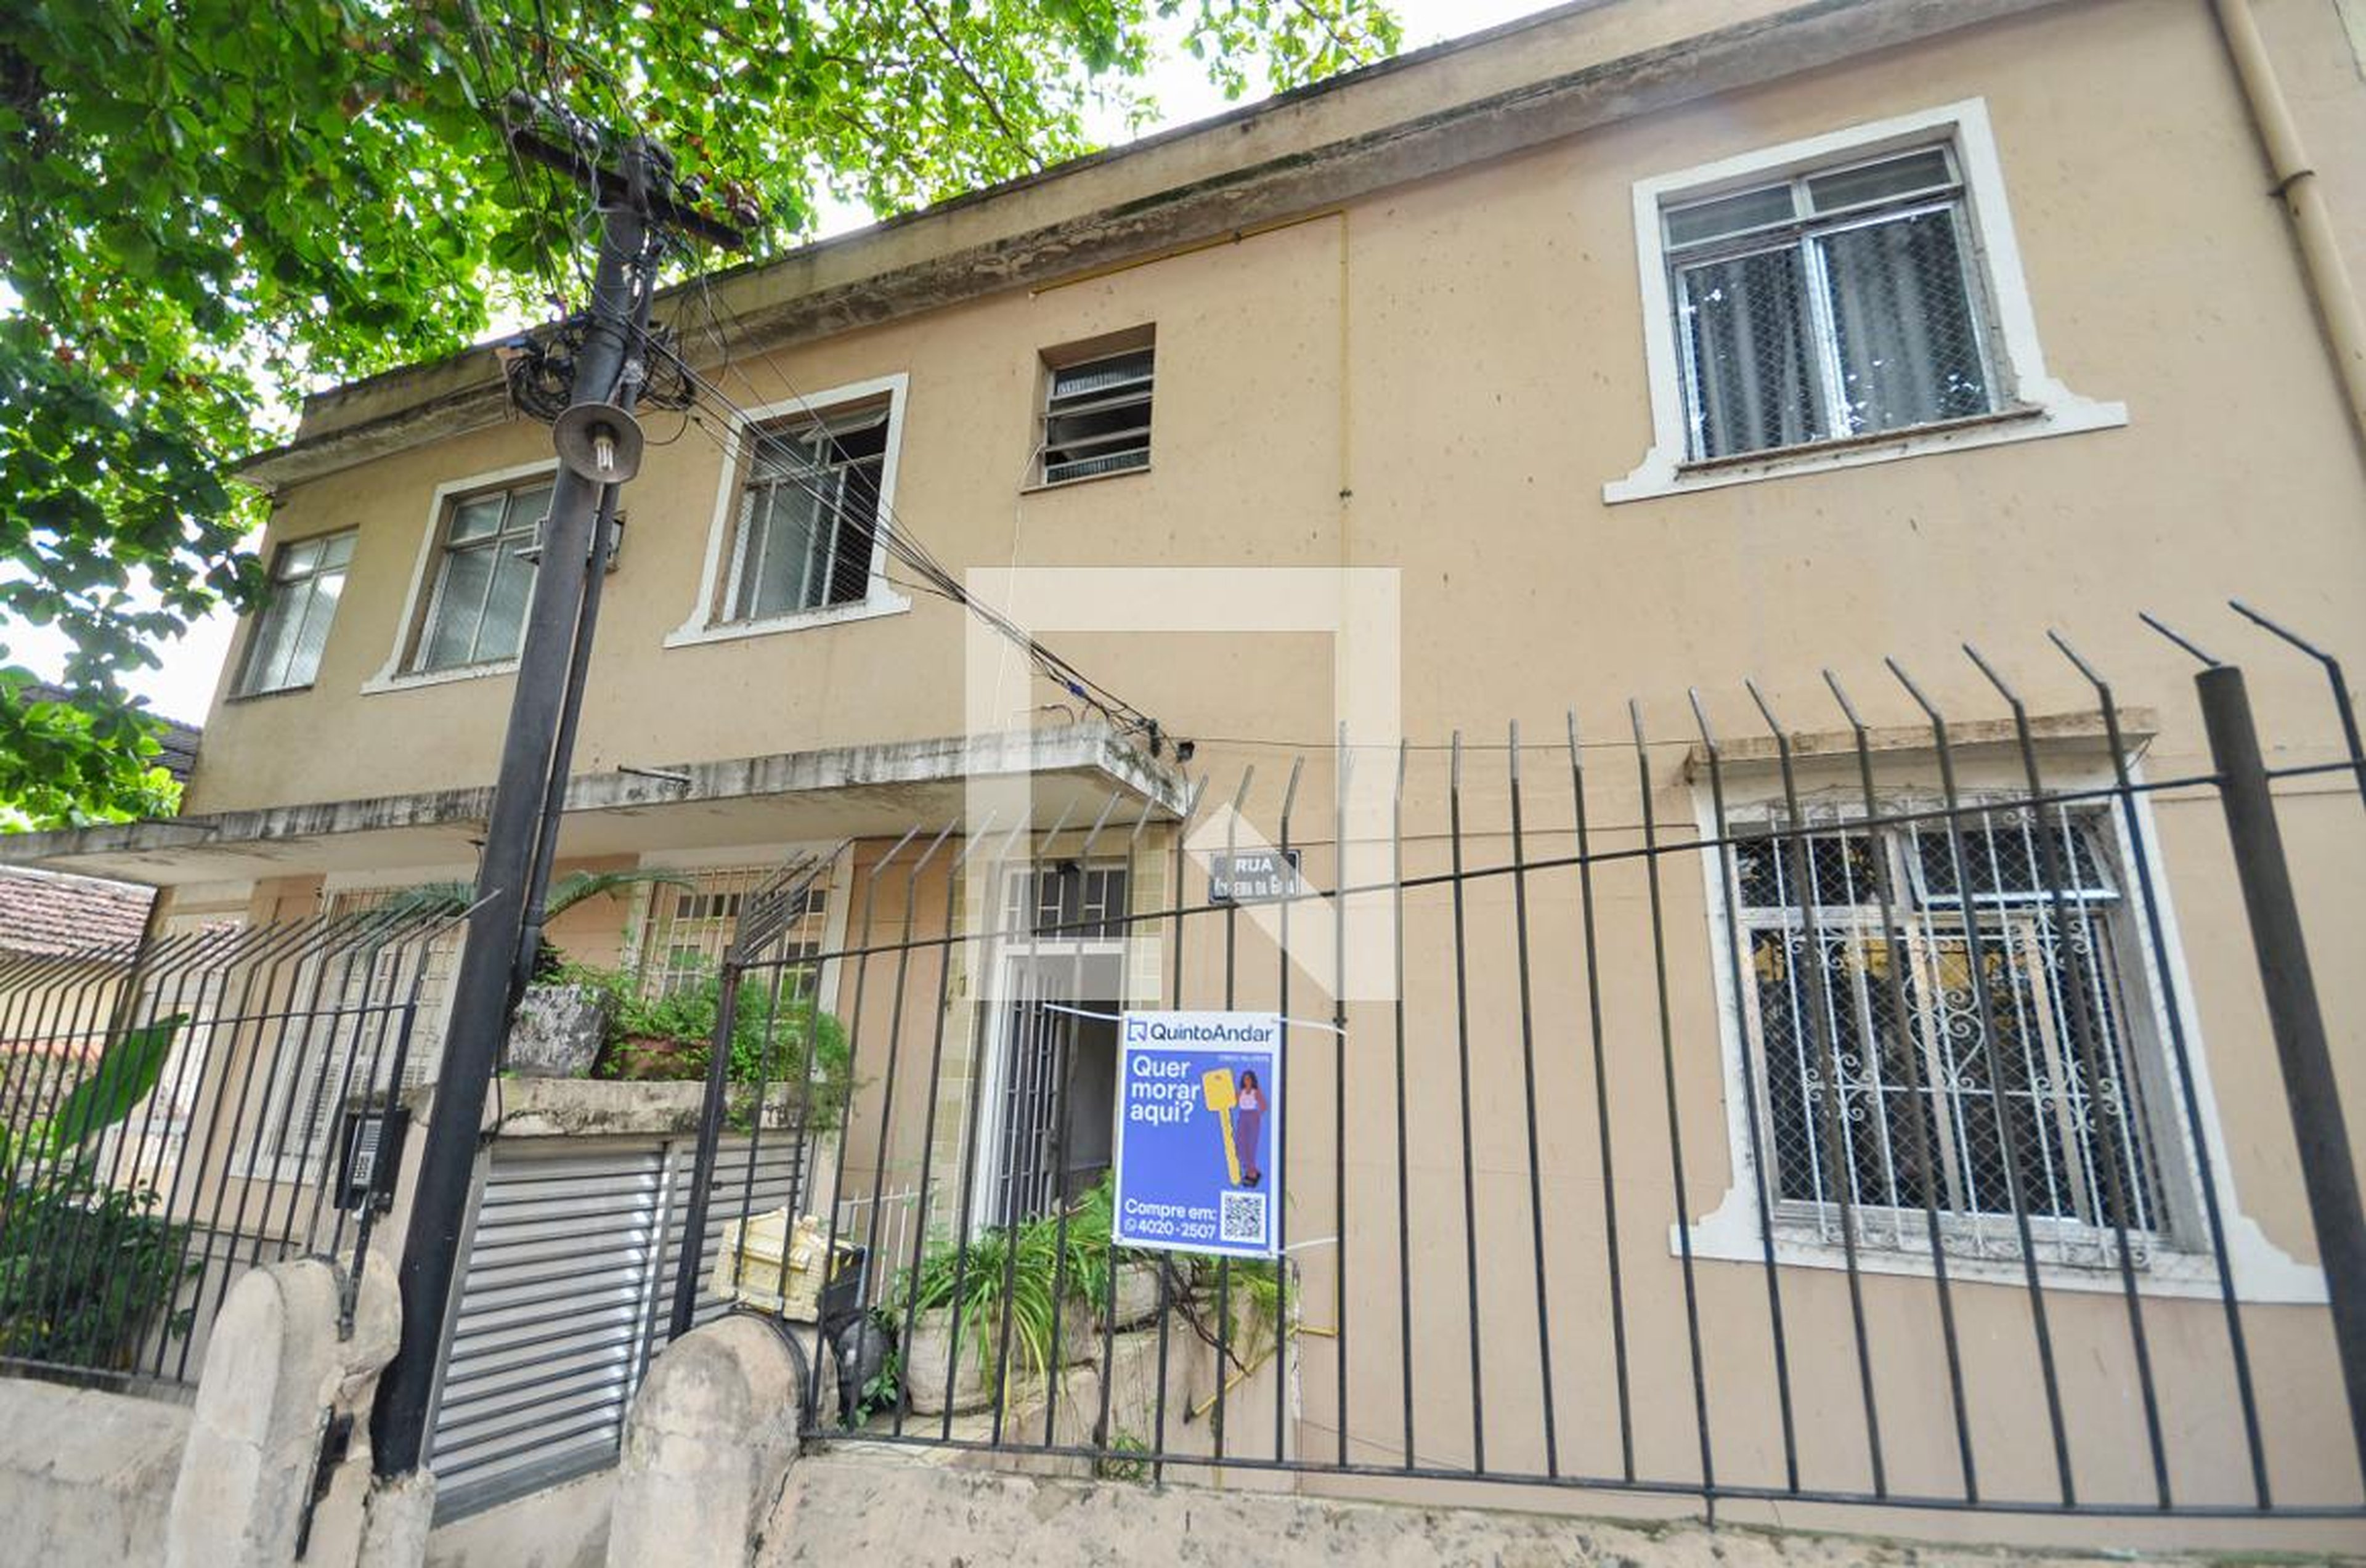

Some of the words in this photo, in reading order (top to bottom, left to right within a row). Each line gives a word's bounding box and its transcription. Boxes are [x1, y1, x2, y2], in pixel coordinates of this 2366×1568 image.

[1235, 857, 1274, 873] RUA
[1150, 1023, 1273, 1042] QuintoAndar
[1132, 1055, 1190, 1078] Quer
[1131, 1082, 1200, 1100] morar
[1130, 1100, 1194, 1126] aqui?
[1124, 1198, 1185, 1220] Compre
